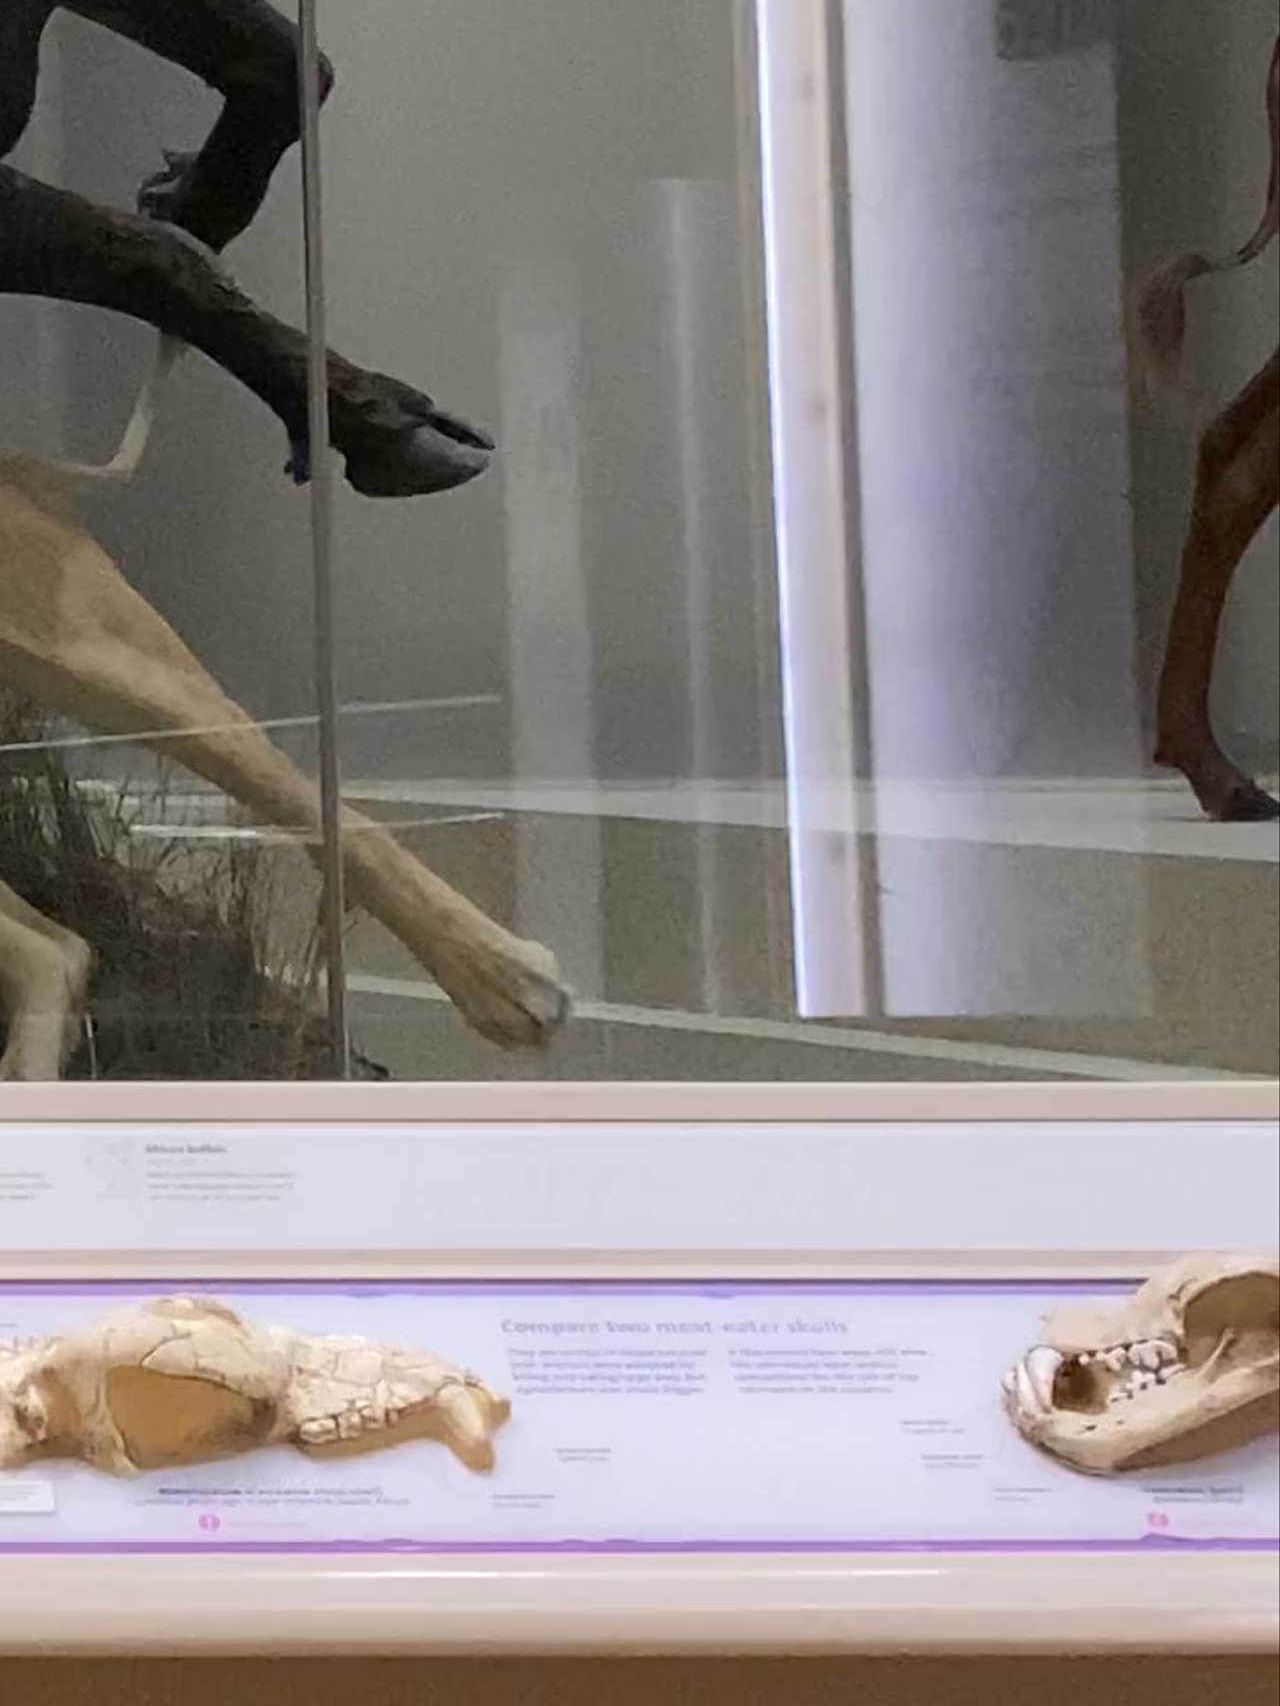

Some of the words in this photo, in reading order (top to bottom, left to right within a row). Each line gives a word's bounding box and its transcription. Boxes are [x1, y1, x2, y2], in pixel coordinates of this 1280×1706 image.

[500, 1320, 599, 1336] Compare
[605, 1320, 650, 1334] two
[786, 1318, 850, 1334] skulls
